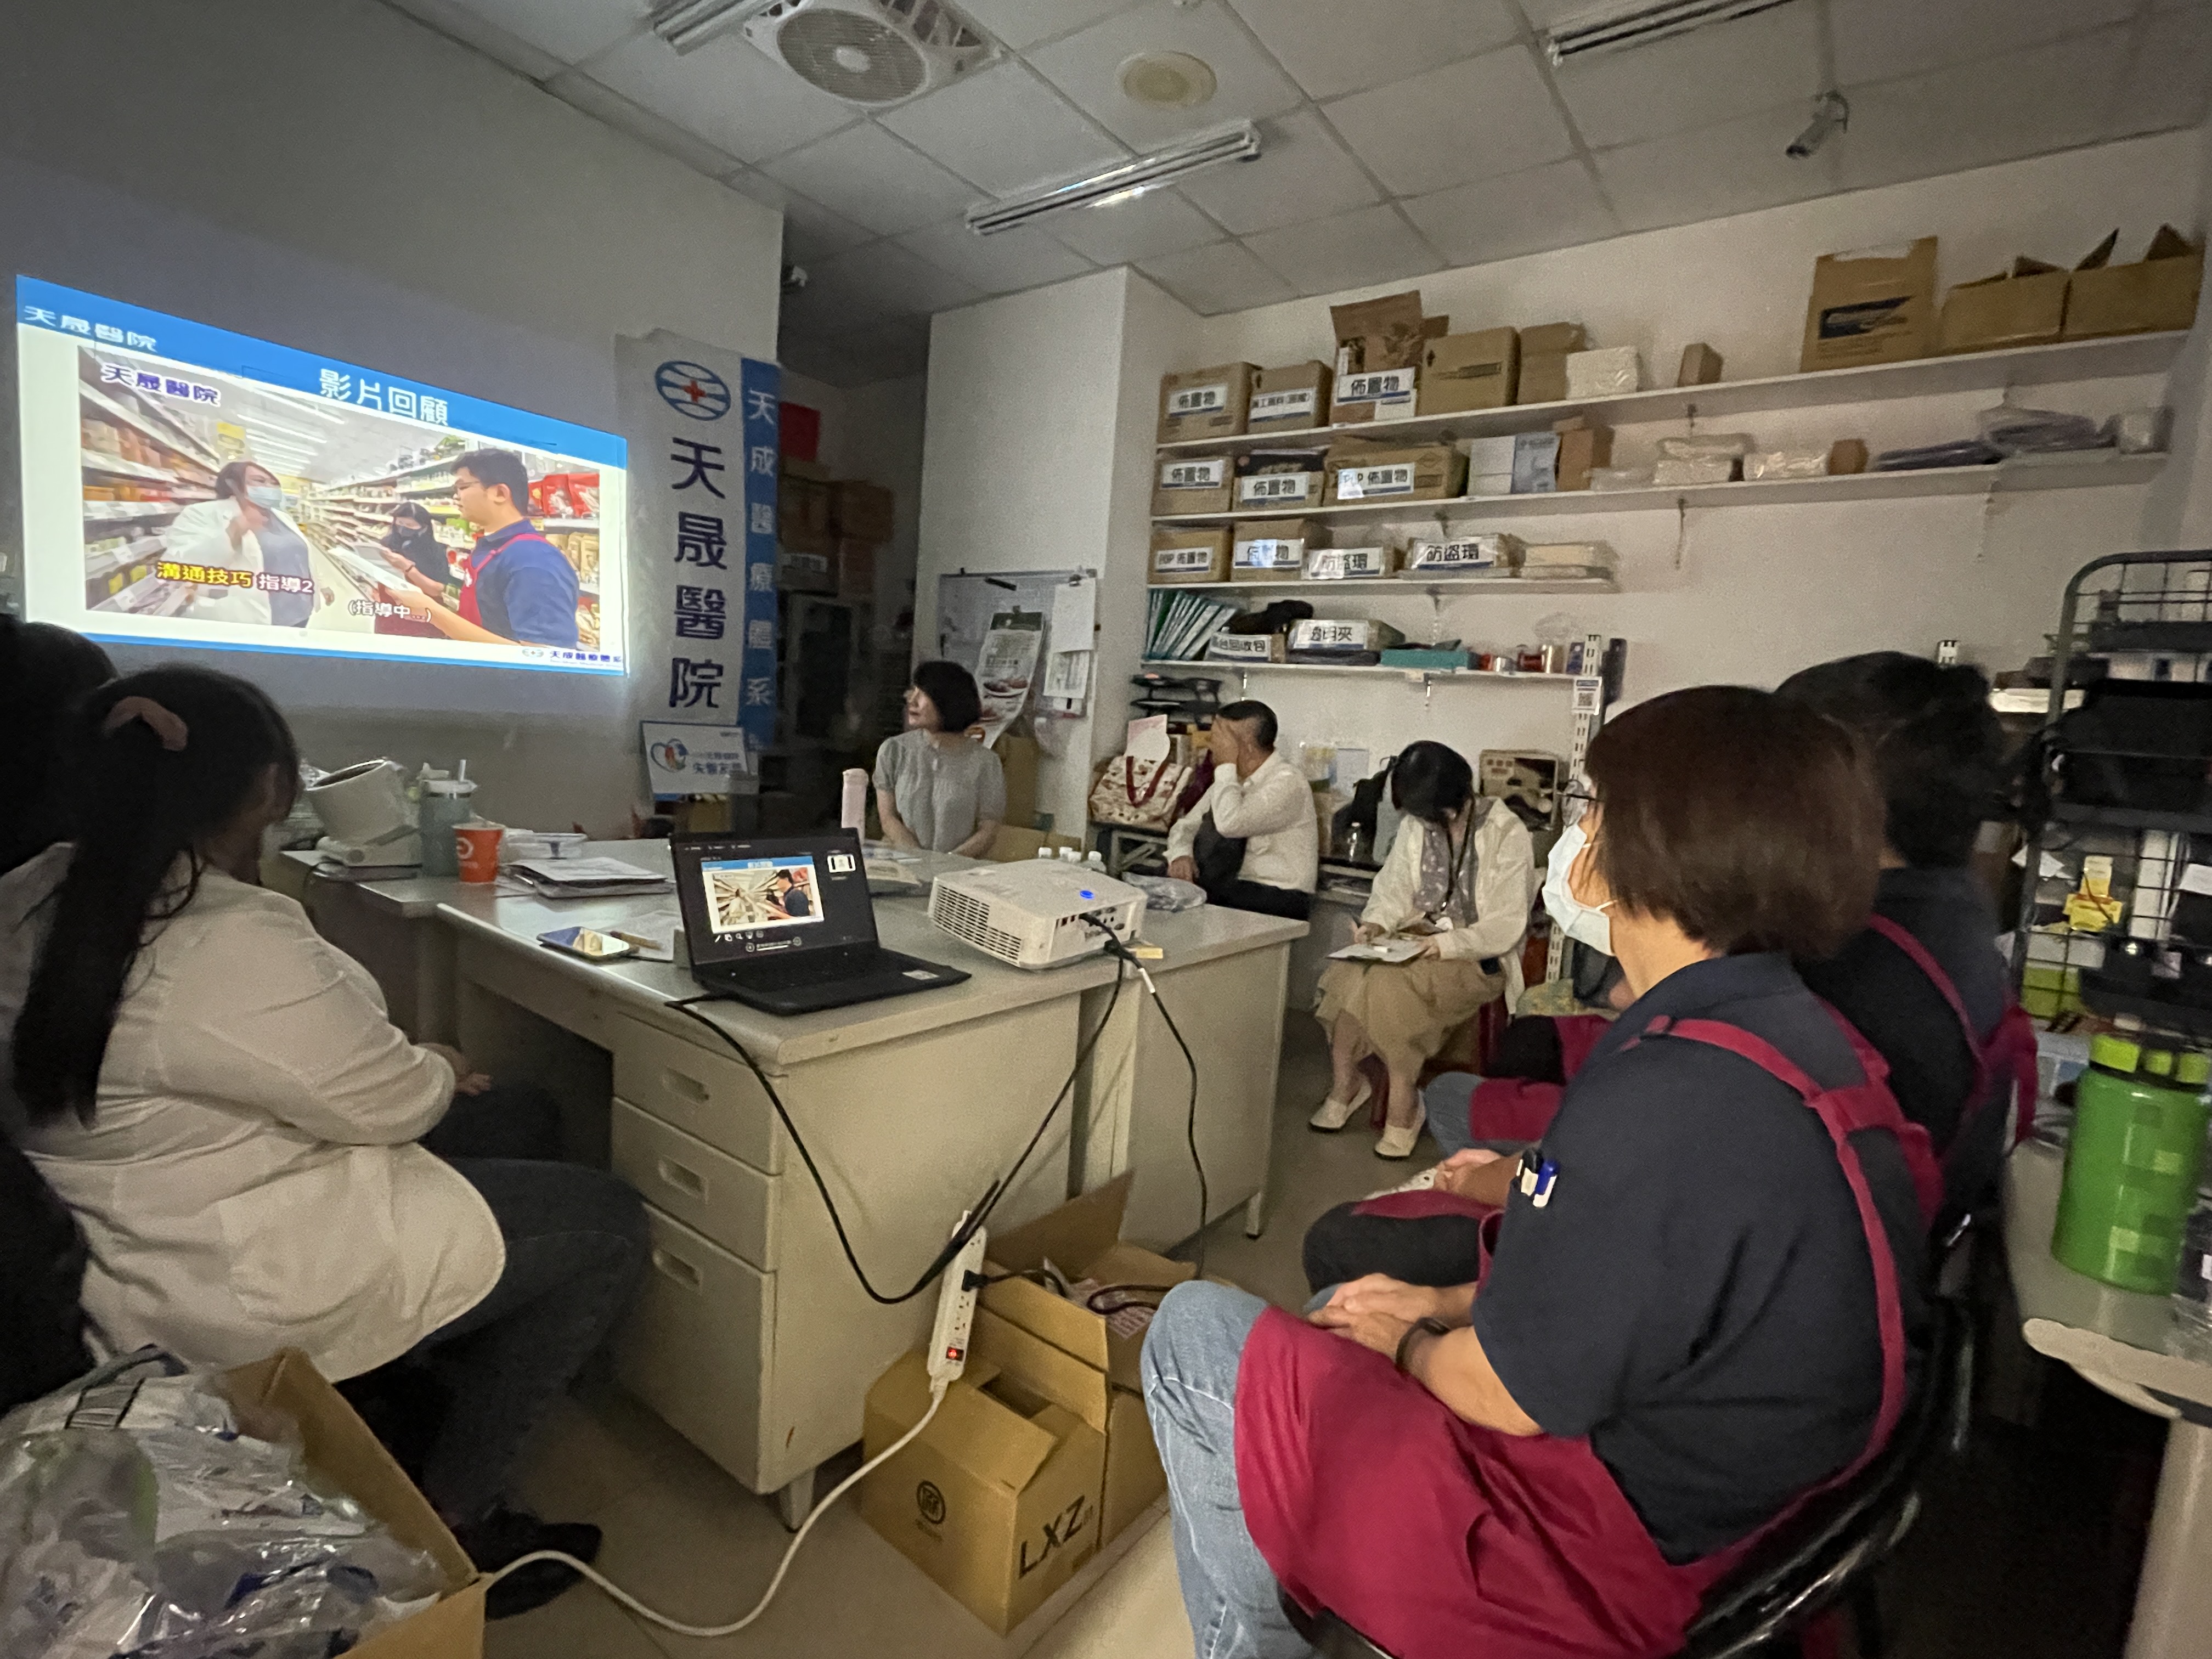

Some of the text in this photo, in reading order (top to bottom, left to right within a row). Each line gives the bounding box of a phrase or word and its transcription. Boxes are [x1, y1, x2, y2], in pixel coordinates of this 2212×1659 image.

[24, 305, 158, 353] 天晟醫院
[102, 363, 221, 407] 天晟醫院
[319, 368, 449, 426] 影片回顧
[157, 562, 314, 594] 溝通技巧 指導2
[669, 437, 727, 708] 天晟醫院
